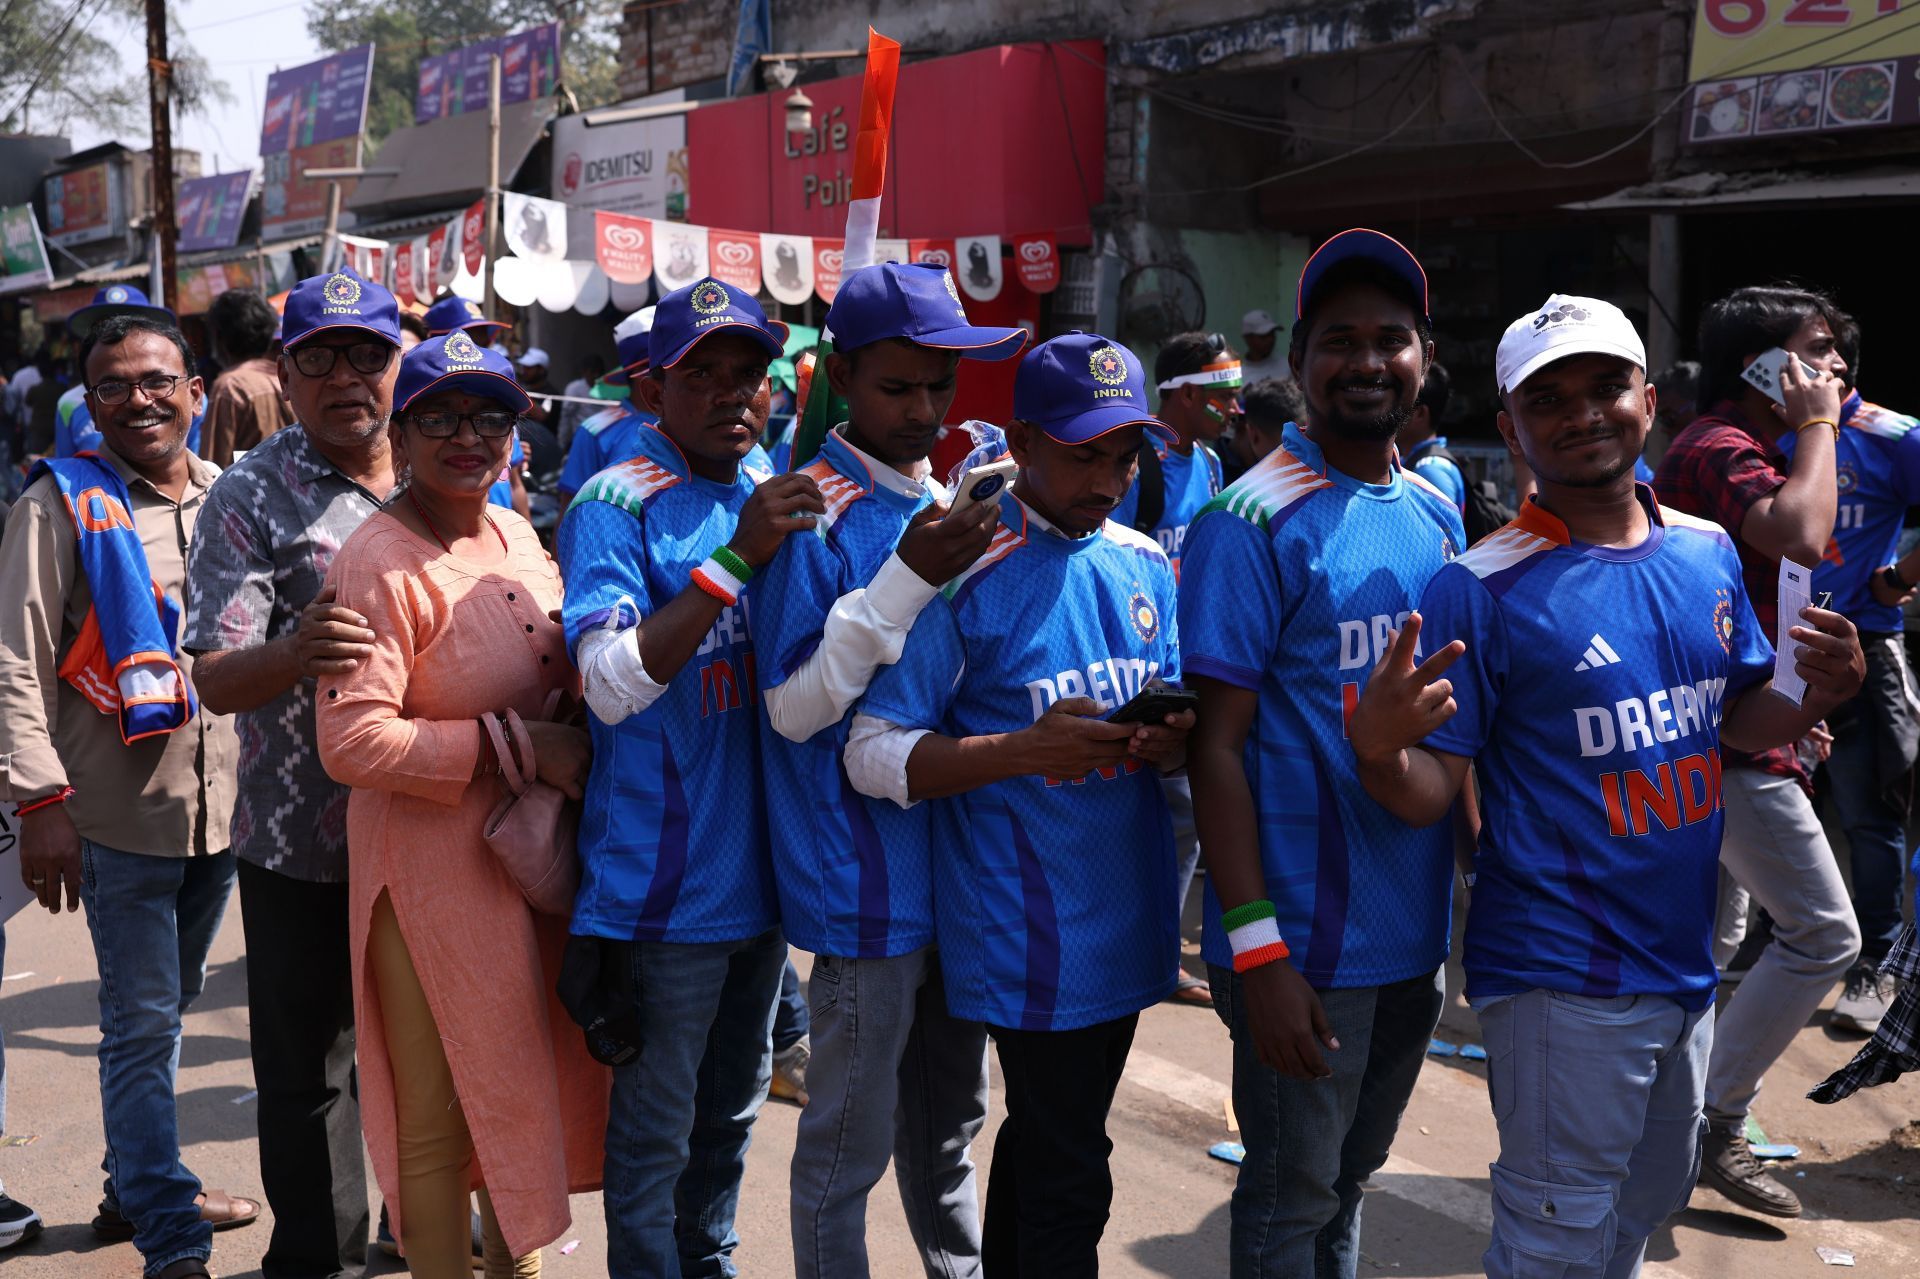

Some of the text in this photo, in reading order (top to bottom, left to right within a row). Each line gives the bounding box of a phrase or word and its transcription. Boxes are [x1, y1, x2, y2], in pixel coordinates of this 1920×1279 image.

[585, 149, 653, 184] IDEMITSU
[323, 306, 361, 315] INDIA
[695, 316, 735, 328] INDIA
[1093, 388, 1133, 399] INDIA
[1839, 503, 1865, 529] 11
